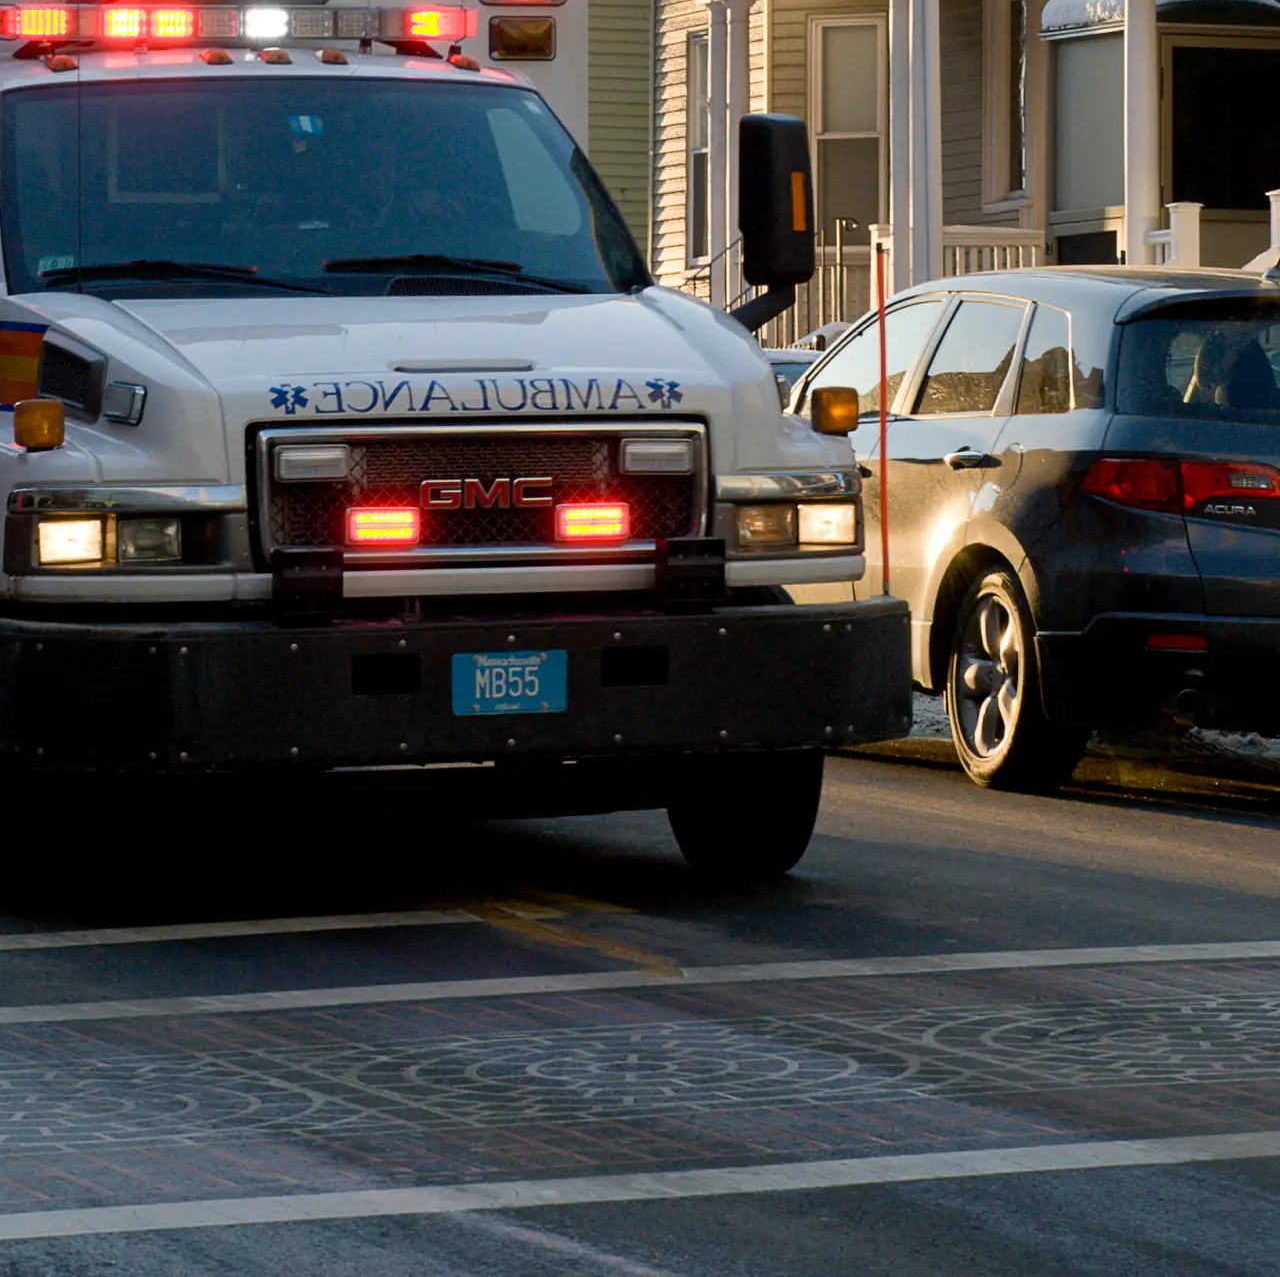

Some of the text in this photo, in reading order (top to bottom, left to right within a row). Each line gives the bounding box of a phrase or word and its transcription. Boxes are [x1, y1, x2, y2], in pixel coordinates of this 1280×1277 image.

[419, 476, 554, 510] GMC
[1203, 503, 1257, 516] ACURA
[475, 666, 540, 700] MB55
